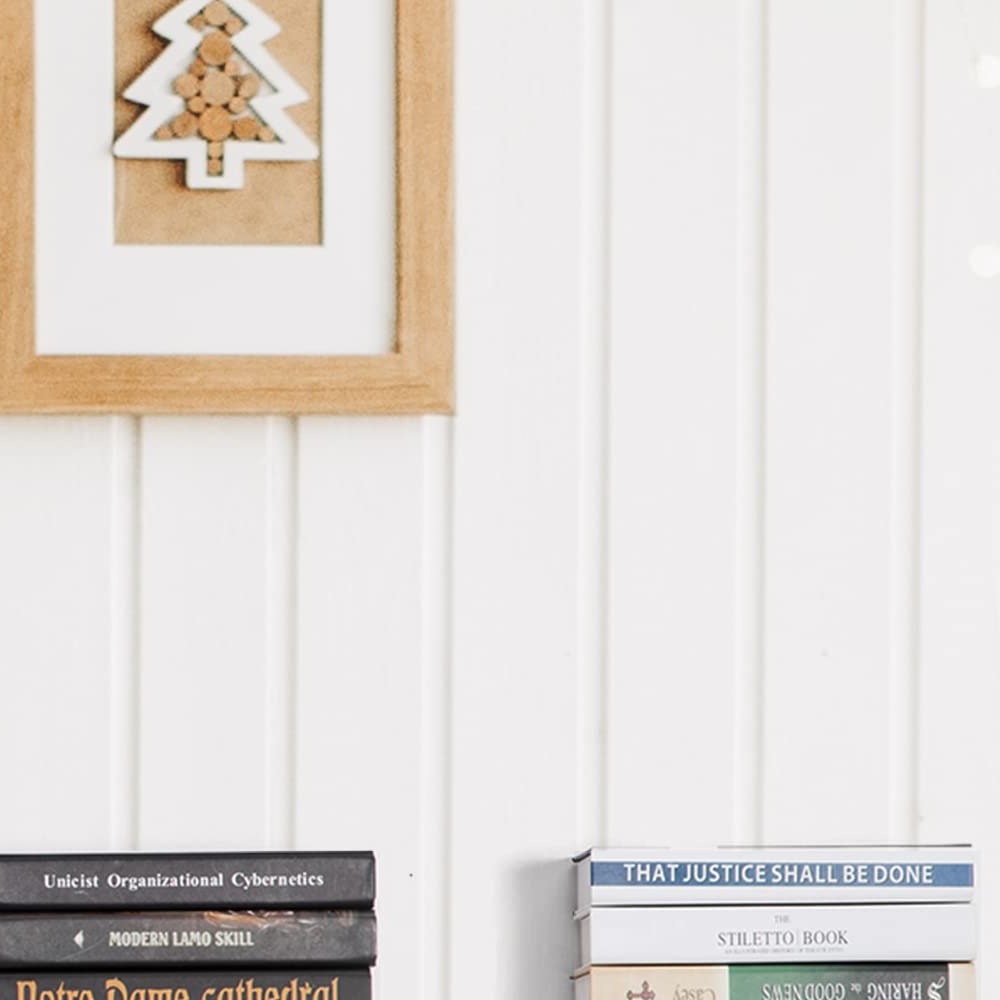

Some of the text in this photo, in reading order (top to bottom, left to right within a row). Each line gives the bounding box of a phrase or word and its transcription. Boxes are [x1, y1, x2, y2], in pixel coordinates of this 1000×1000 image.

[43, 871, 324, 891] Unicist Organizational Cybernetics
[624, 863, 934, 884] THAT JUSTICE SHALL BE DONE
[108, 931, 255, 947] MODERN LAMO SKILL
[717, 929, 849, 946] STILETTO BOOK
